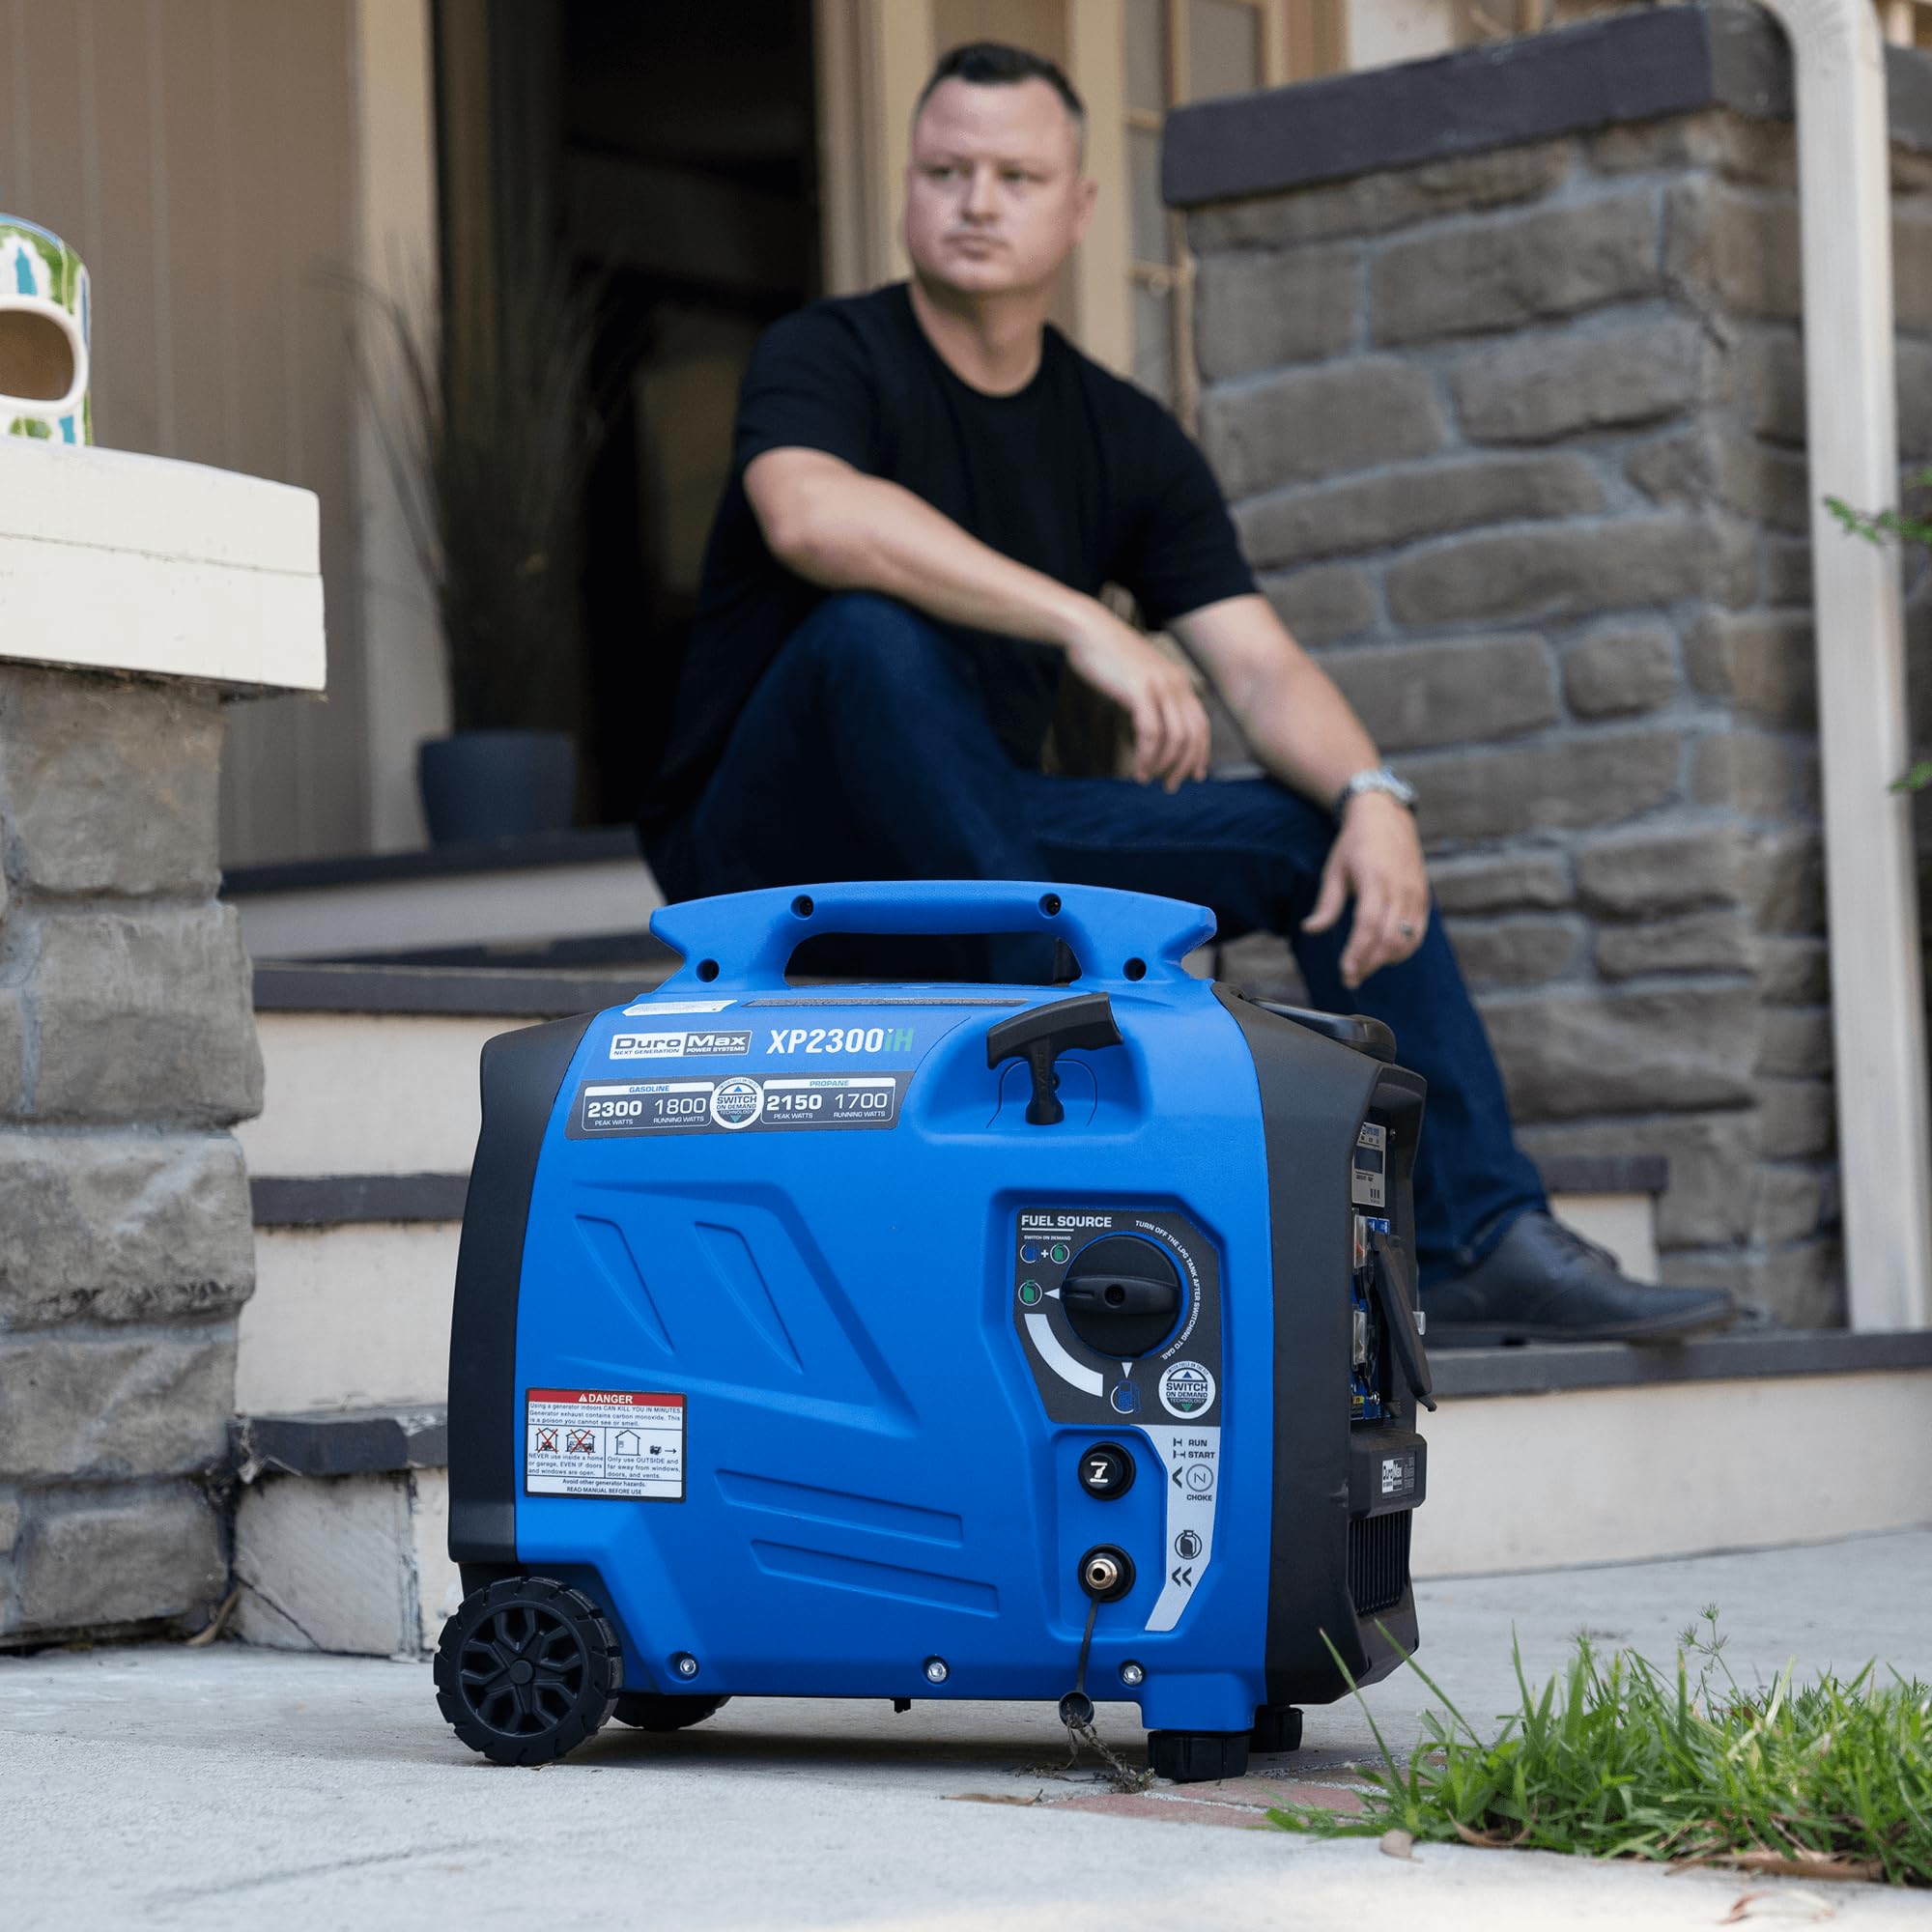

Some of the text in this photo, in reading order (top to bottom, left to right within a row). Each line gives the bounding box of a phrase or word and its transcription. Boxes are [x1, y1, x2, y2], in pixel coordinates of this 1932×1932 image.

[654, 1097, 707, 1115] 1800
[717, 1096, 757, 1104] SWITCH
[766, 1094, 823, 1111] 2150
[835, 1093, 888, 1109] 1700
[587, 1100, 642, 1118] 2300
[1021, 1215, 1112, 1228] FUEL SOURCE
[1136, 1220, 1155, 1231] TURN
[1155, 1226, 1168, 1237] OFF
[1167, 1235, 1180, 1247] THE
[1177, 1245, 1189, 1259] LPG
[1186, 1258, 1198, 1278] TANK
[1181, 1302, 1200, 1341] SWITCHING
[1174, 1340, 1183, 1350] TO
[1166, 1382, 1208, 1392] SWITCH
[588, 1393, 633, 1405] DANGER
